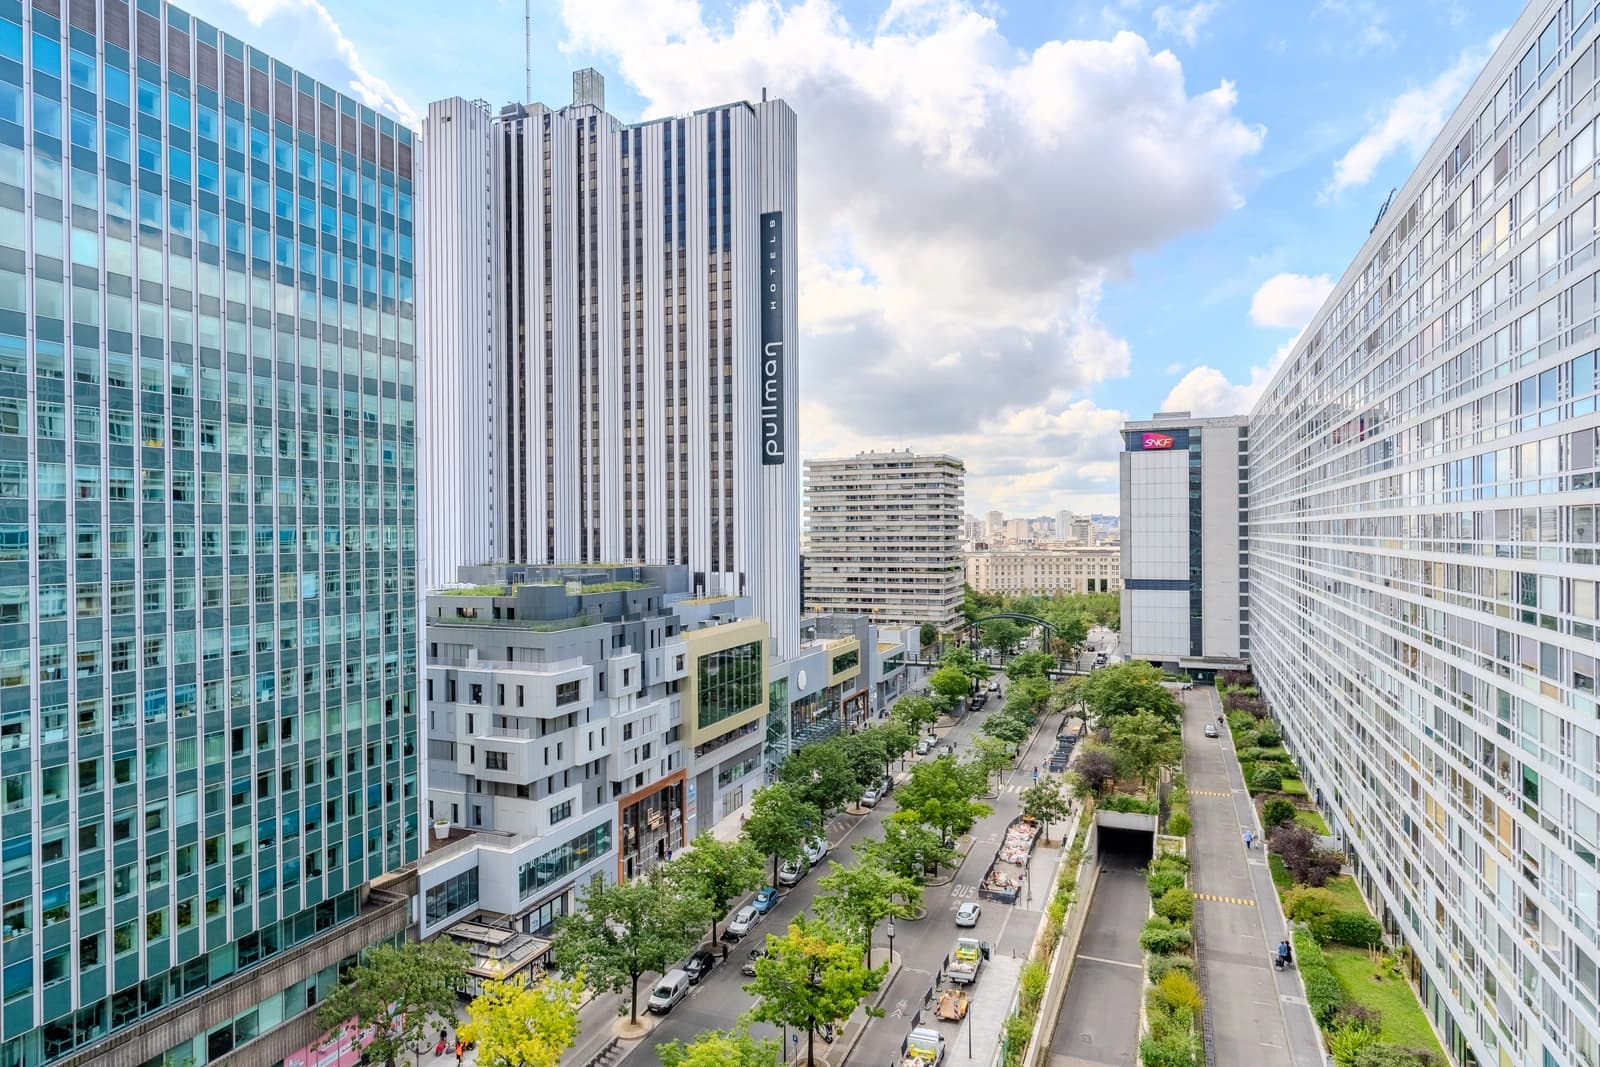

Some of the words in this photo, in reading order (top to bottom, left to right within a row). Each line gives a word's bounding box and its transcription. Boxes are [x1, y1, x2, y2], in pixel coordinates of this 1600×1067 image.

[769, 220, 777, 310] HOTELS
[761, 341, 784, 456] pullman
[1144, 438, 1172, 447] SNCF
[951, 884, 976, 898] BUS
